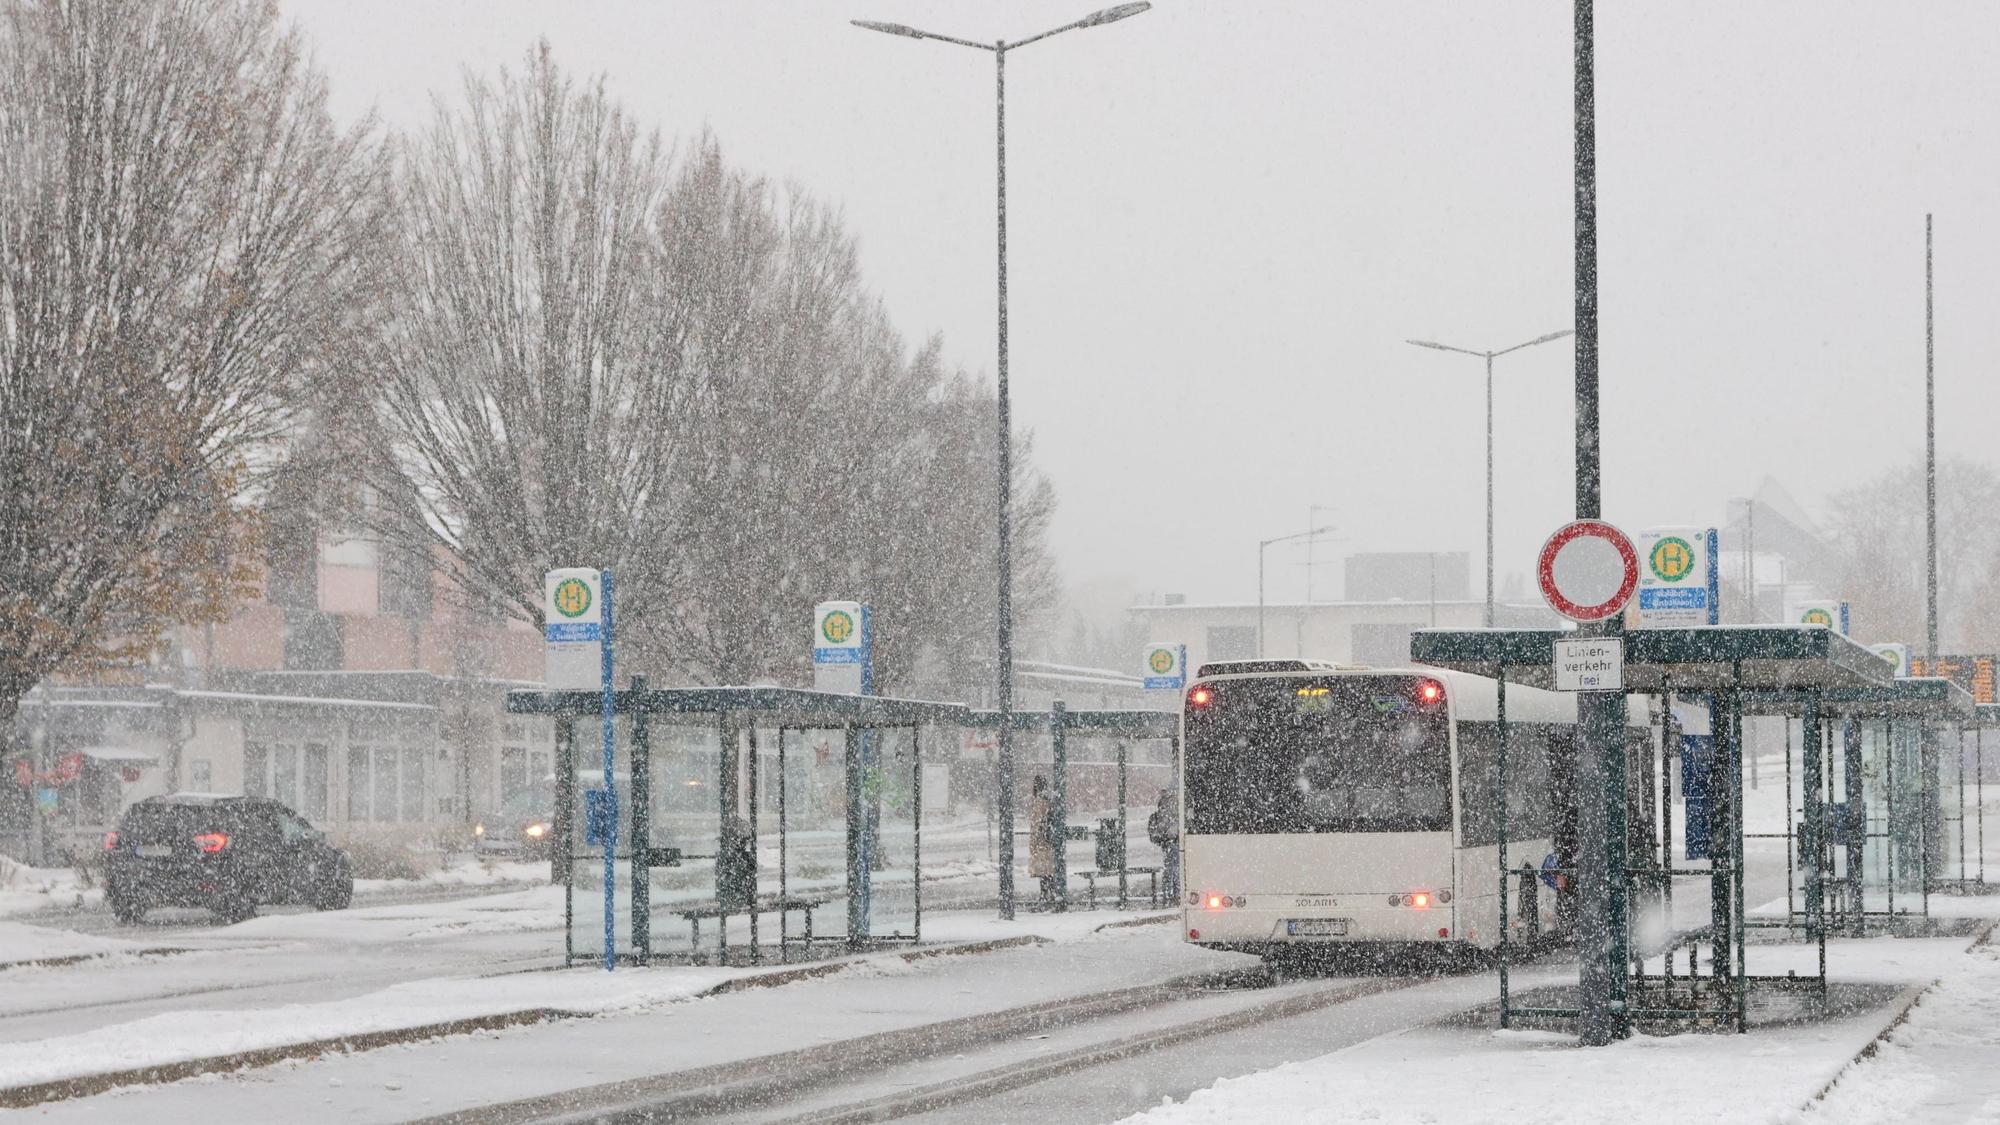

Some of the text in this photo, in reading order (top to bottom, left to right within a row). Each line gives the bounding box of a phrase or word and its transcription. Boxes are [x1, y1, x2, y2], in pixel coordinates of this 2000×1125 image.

[1662, 547, 1681, 572] H
[565, 586, 580, 609] H
[830, 617, 844, 636] H
[1567, 646, 1610, 657] Linien-
[1564, 660, 1613, 672] verkehr
[1579, 673, 1600, 686] frei
[1295, 899, 1338, 907] SOLARIS
